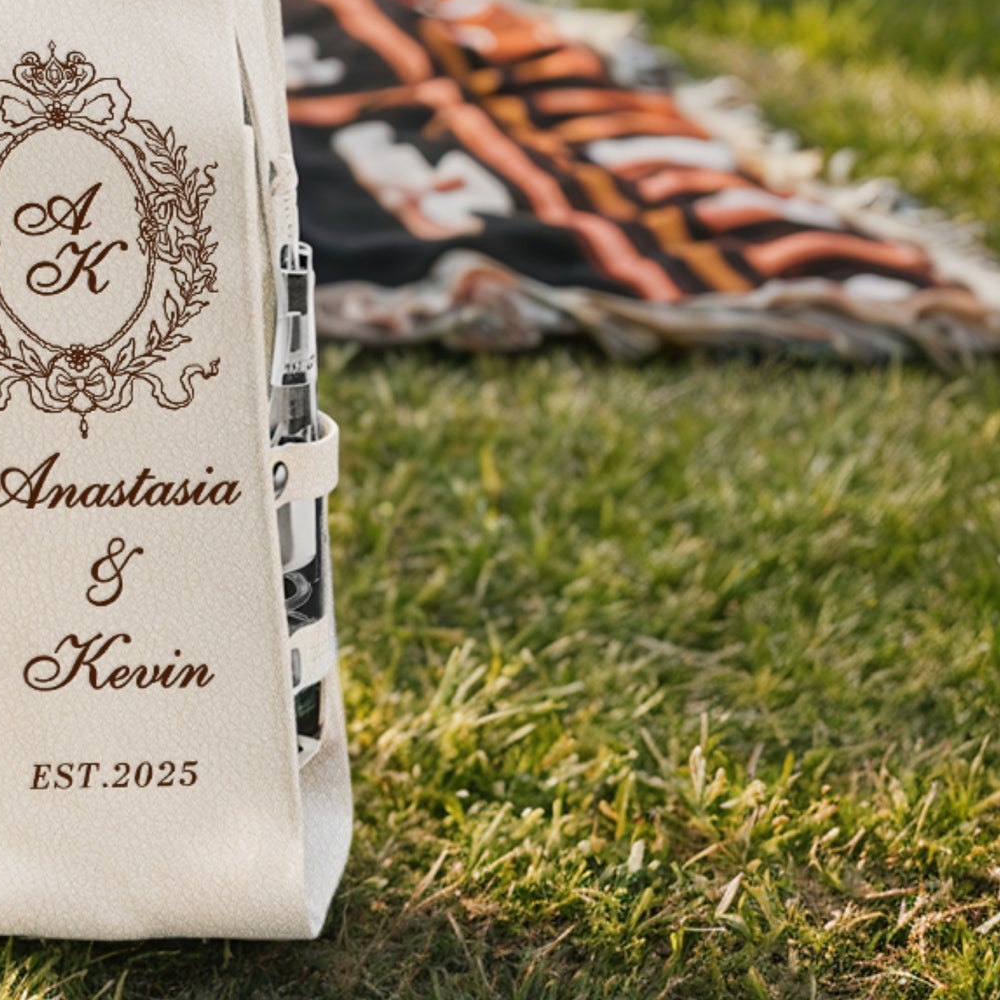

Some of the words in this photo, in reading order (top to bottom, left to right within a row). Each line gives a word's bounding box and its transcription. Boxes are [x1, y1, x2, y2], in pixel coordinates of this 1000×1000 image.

[13, 182, 103, 236] A
[26, 240, 128, 296] K
[86, 537, 144, 607] &
[23, 633, 216, 691] Kevin
[29, 760, 199, 790] EST.2025
